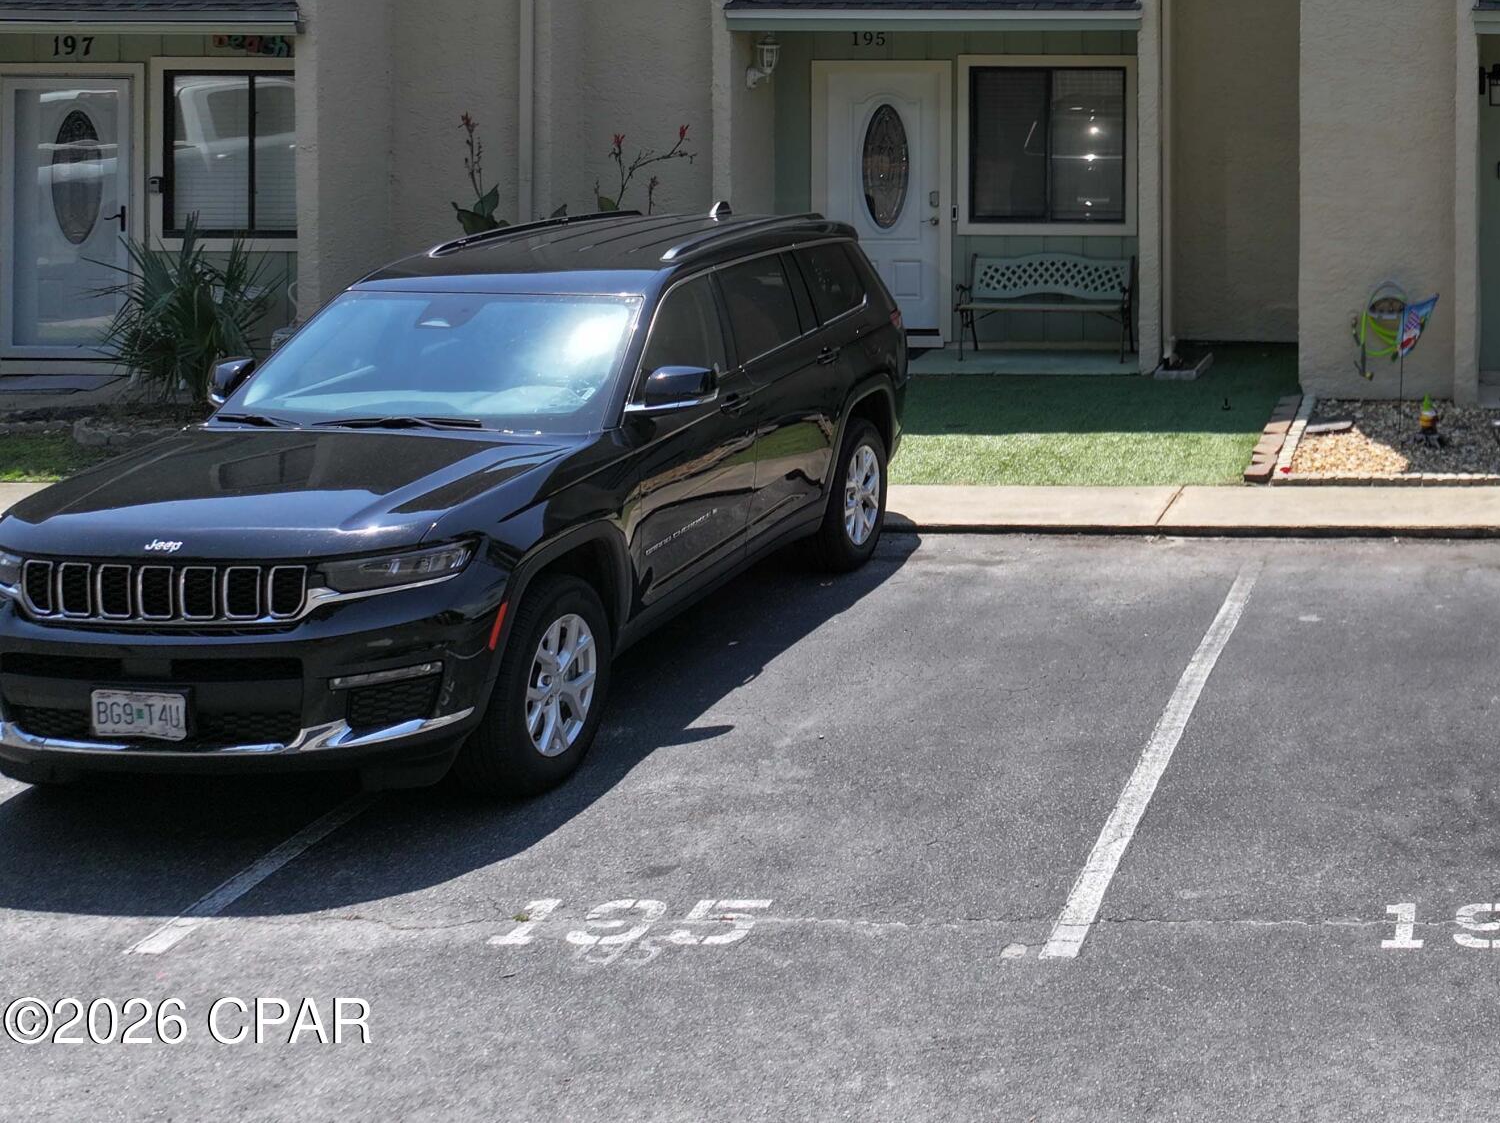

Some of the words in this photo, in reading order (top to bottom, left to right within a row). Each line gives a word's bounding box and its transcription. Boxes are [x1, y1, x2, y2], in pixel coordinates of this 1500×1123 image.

[53, 35, 95, 56] 197
[851, 31, 886, 46] 195
[144, 539, 183, 554] Jeep
[96, 701, 135, 725] BG9
[486, 898, 774, 945] 195
